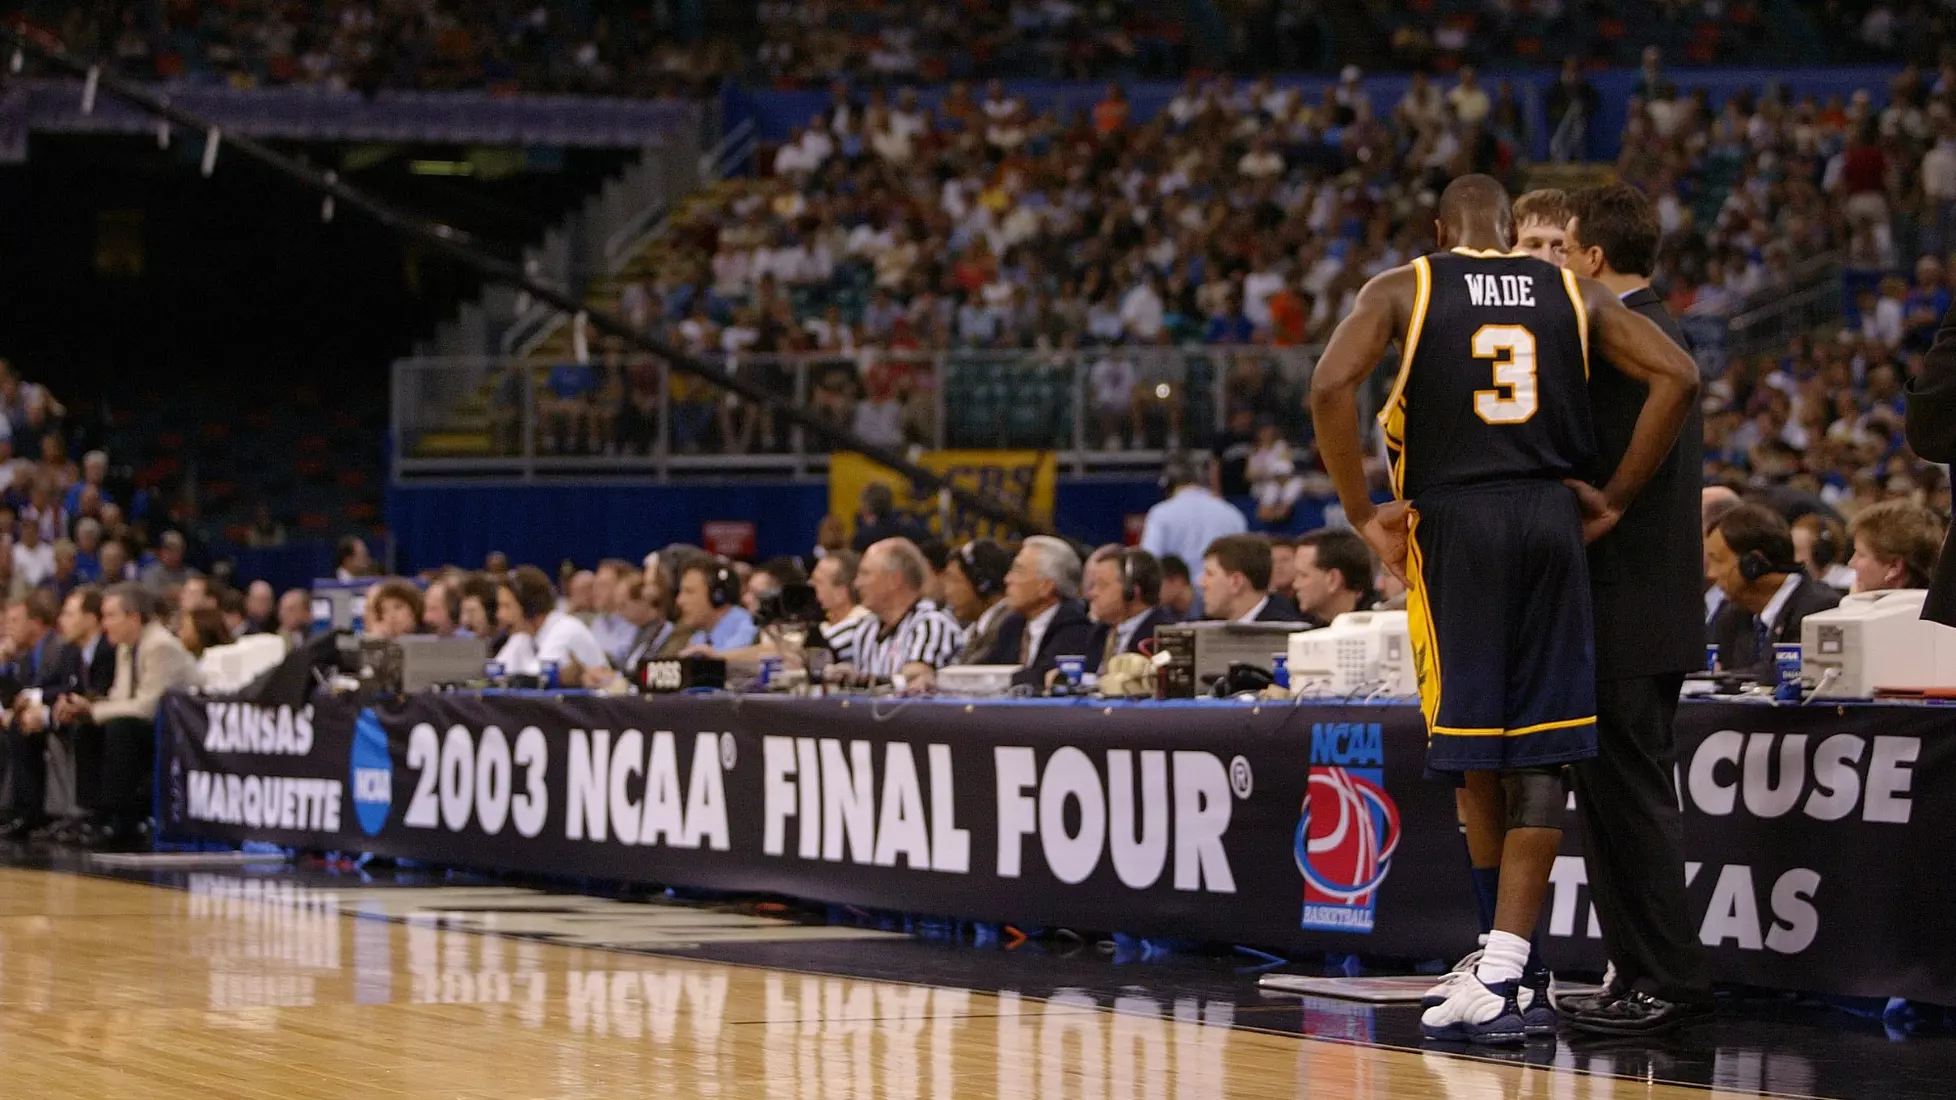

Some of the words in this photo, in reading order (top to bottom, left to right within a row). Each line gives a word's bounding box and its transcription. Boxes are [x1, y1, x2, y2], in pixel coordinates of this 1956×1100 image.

[1464, 273, 1536, 307] WADE
[1471, 324, 1539, 425] 3
[647, 660, 682, 689] POSS
[1311, 723, 1384, 764] NCAA
[187, 770, 343, 833] MARQUETTE
[403, 722, 549, 838] 2003
[763, 735, 971, 874] FINAL
[1302, 905, 1373, 928] BASKETBALL
[1548, 855, 1822, 955] TAS
